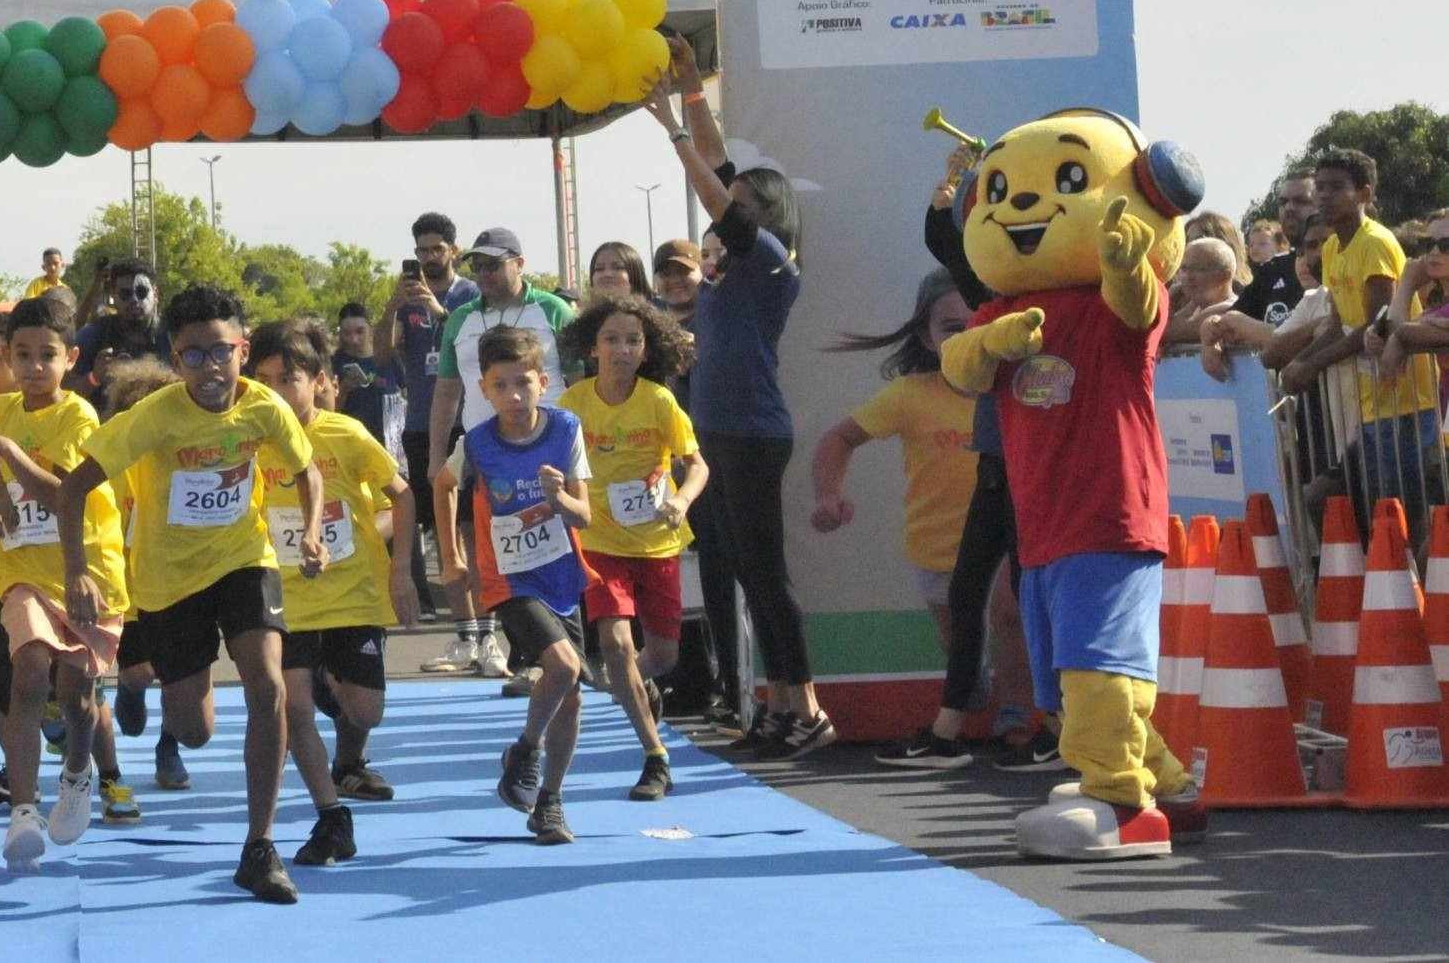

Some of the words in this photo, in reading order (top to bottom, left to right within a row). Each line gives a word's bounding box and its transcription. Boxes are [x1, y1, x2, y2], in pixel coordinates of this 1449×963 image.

[816, 17, 862, 29] POSITIVA
[890, 13, 966, 28] CAIXA
[185, 485, 241, 510] 2604
[500, 525, 551, 554] 2704
